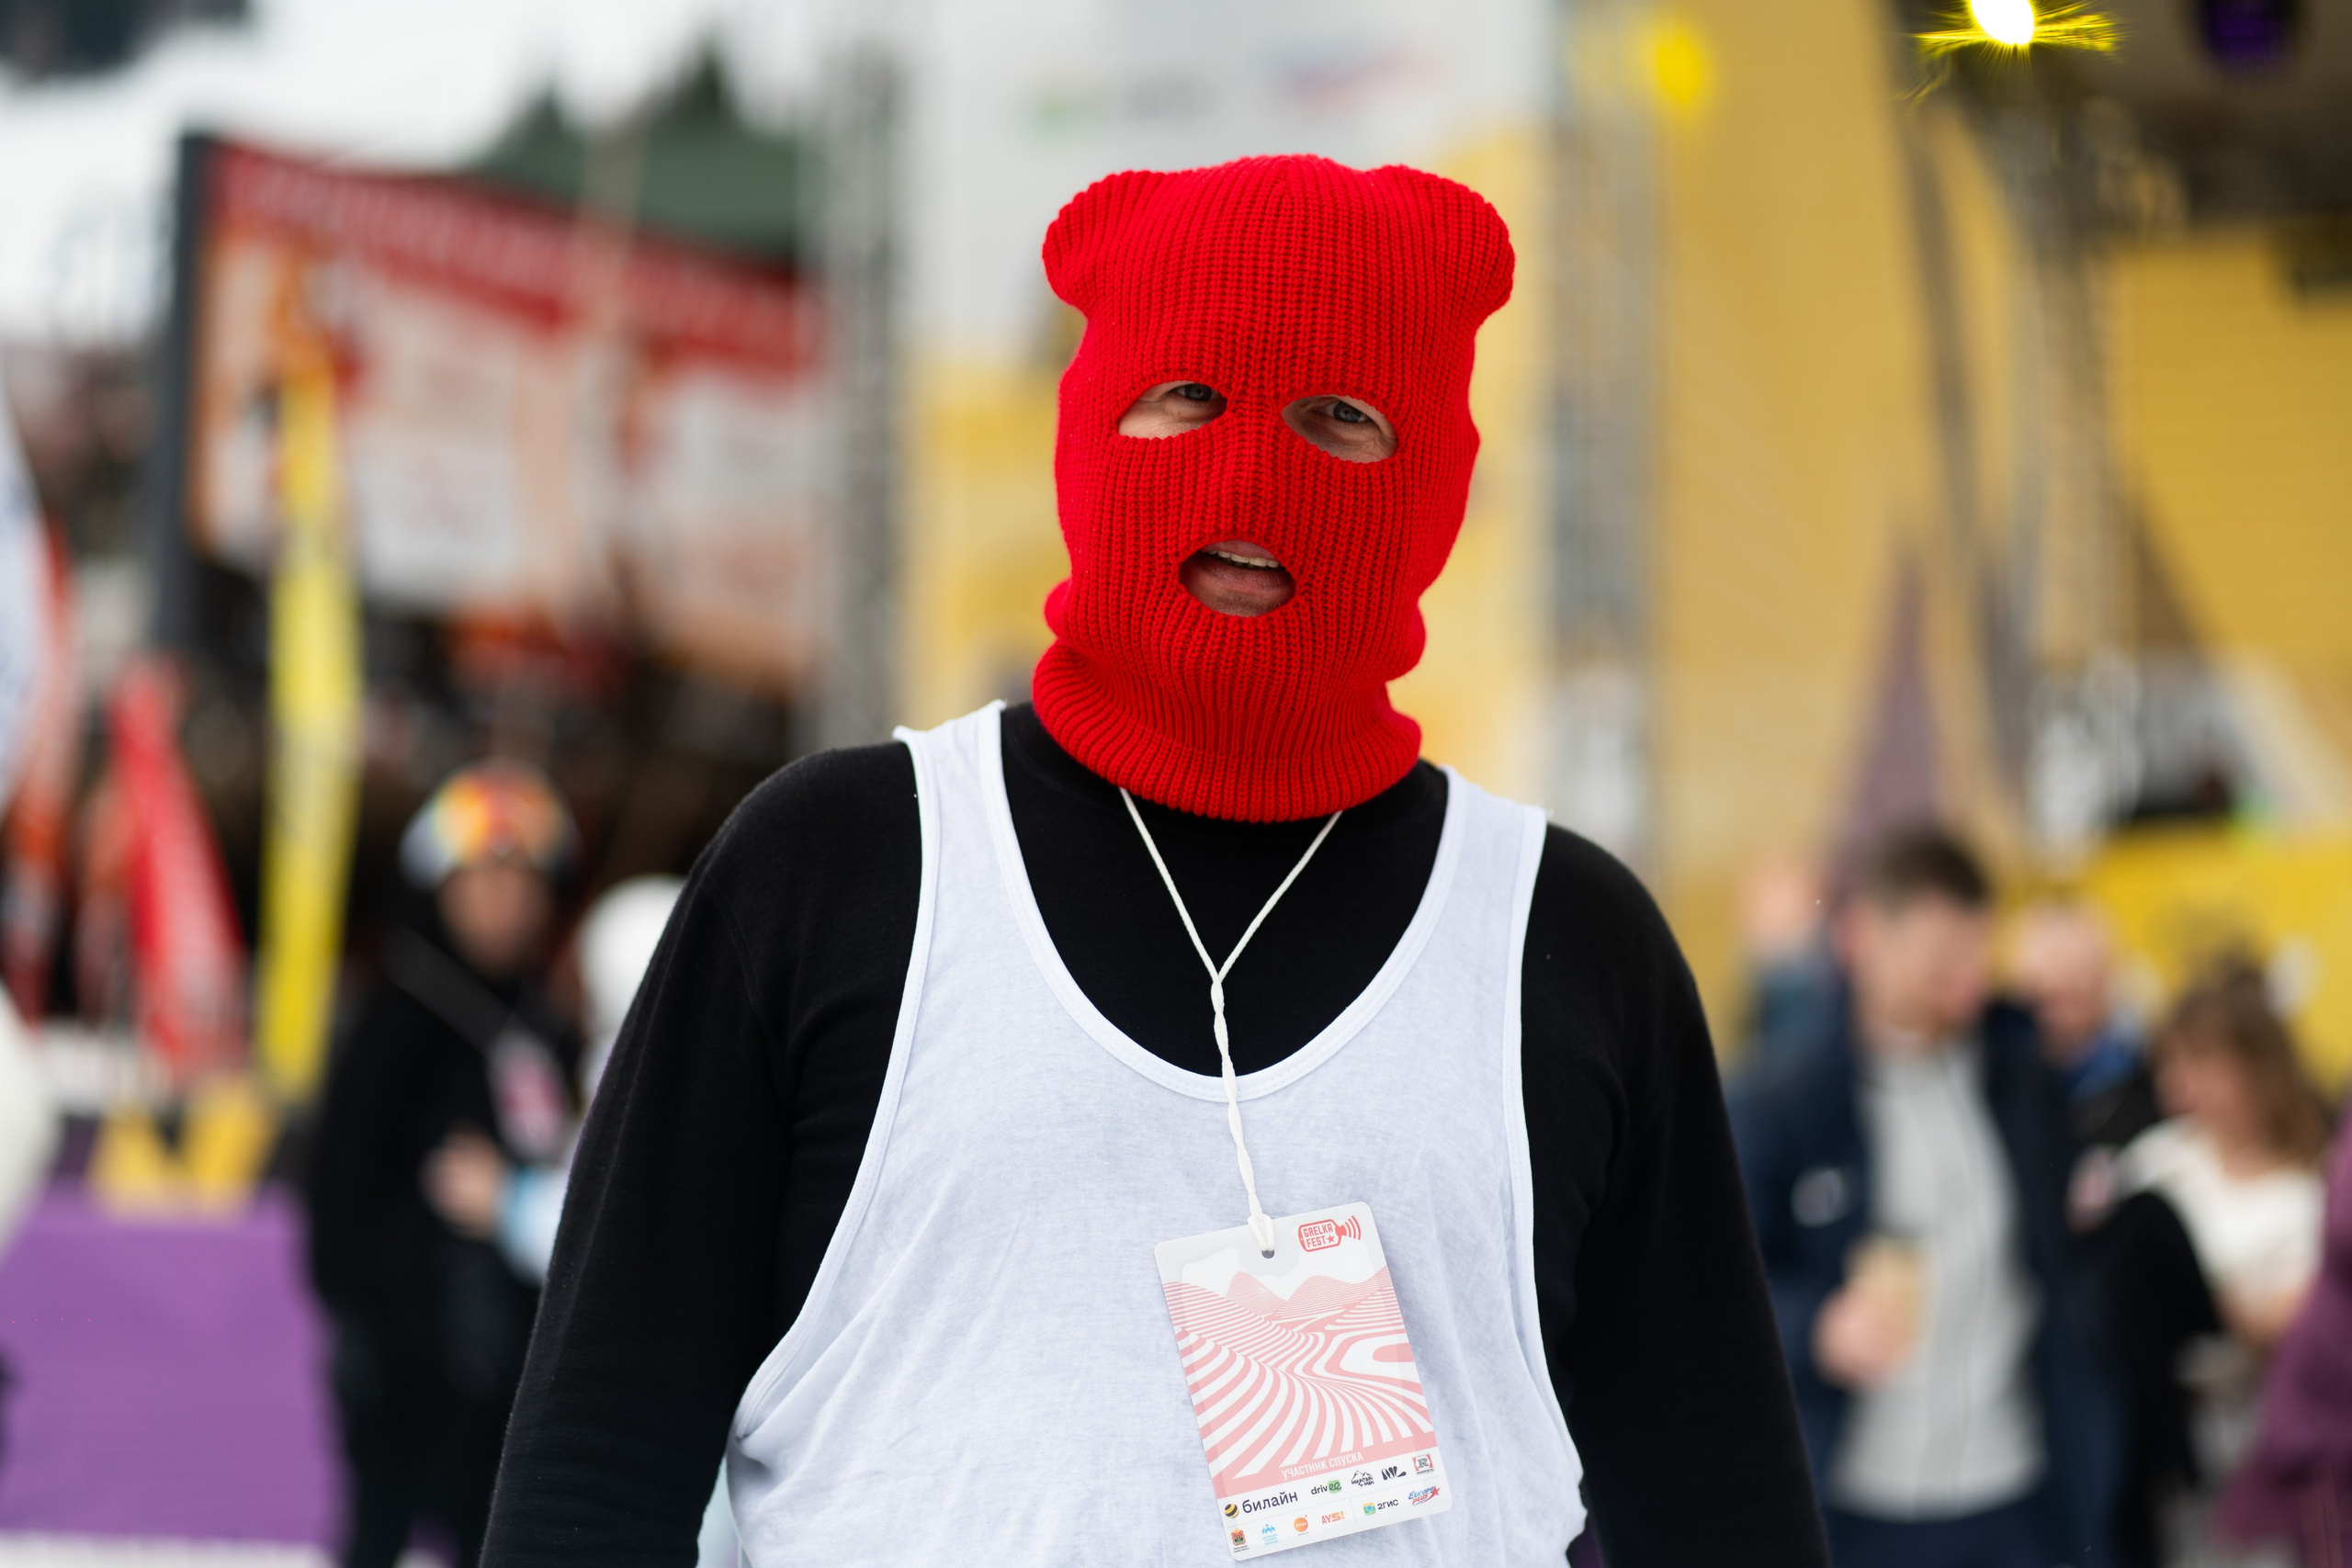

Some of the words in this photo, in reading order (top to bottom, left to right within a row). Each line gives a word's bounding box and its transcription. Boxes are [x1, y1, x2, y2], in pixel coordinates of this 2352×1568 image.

[1303, 1223, 1333, 1237] GRELKA
[1306, 1235, 1326, 1247] FEST
[1281, 1460, 1328, 1481] УЧАСТНИК
[1329, 1451, 1364, 1468] СПУСКА
[1310, 1482, 1342, 1495] drivee
[1242, 1491, 1298, 1514] билайн
[1377, 1499, 1399, 1510] 2ГИС
[1321, 1511, 1345, 1525] AYS!
